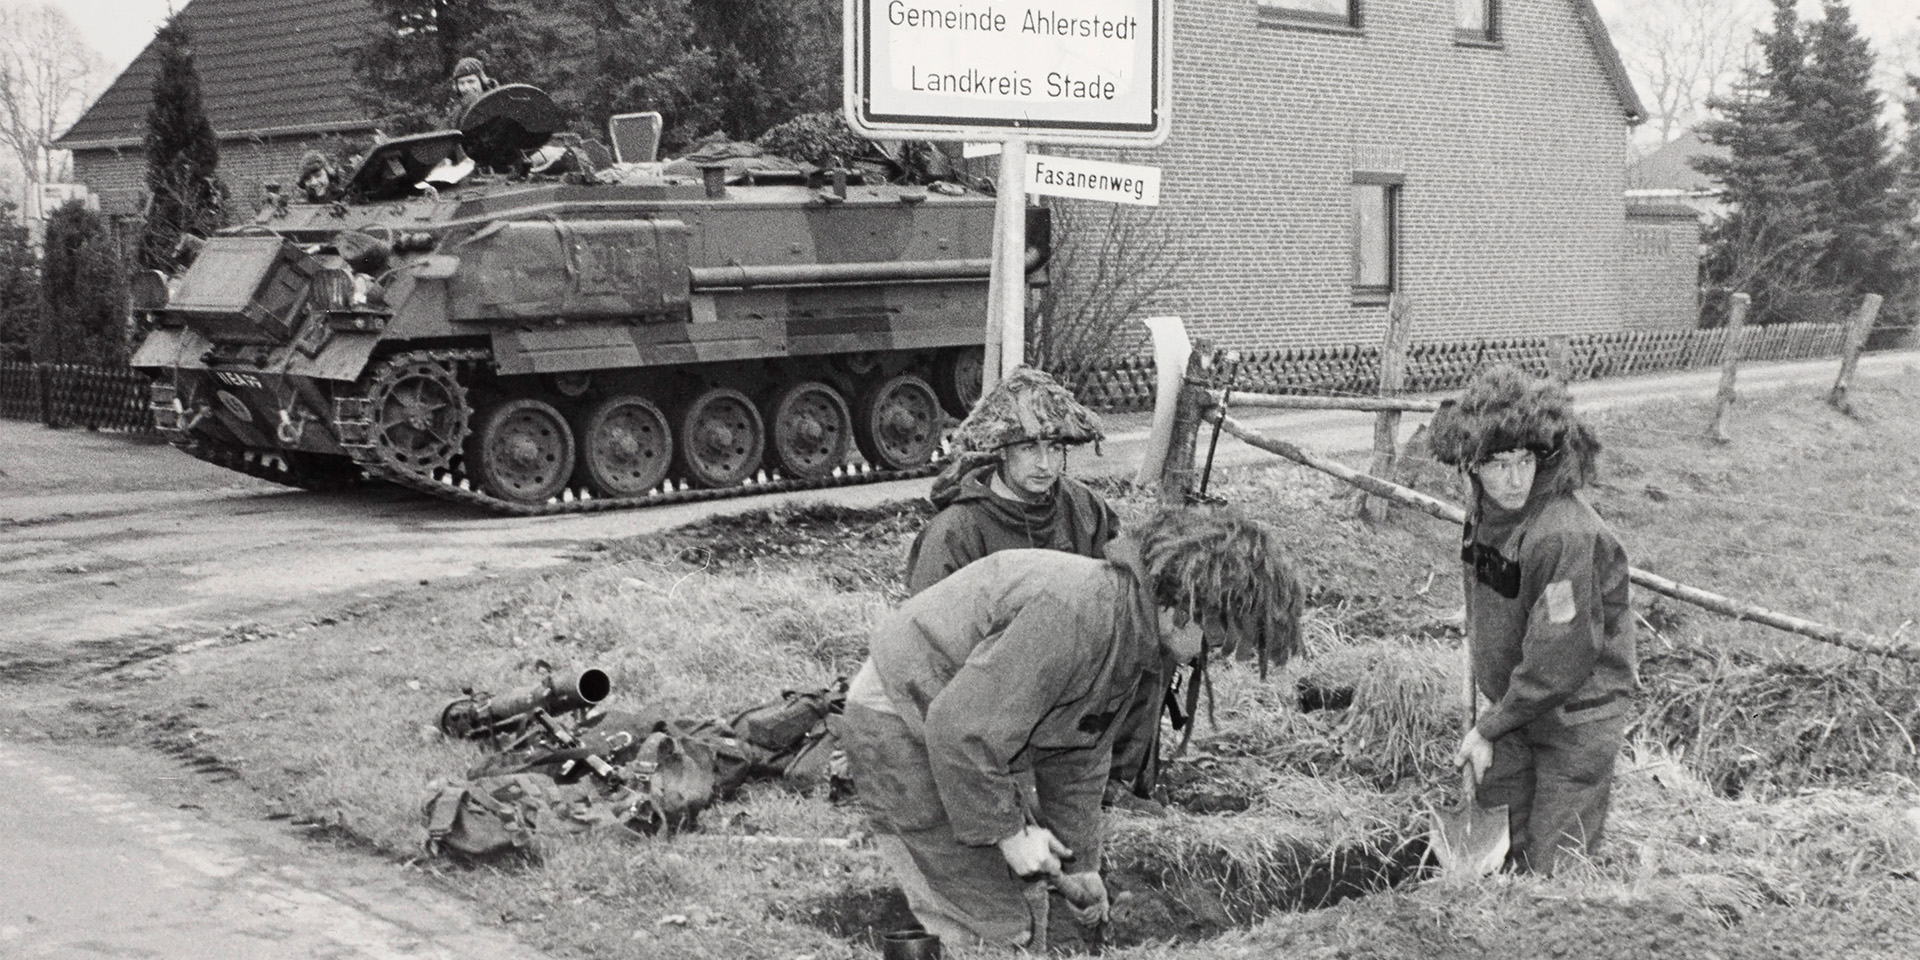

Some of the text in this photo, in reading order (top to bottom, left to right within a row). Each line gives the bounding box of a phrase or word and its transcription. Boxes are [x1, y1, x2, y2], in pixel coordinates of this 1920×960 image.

[888, 0, 1137, 40] Gemeinde Ahlerstedt
[911, 65, 1116, 100] Landkreis Stade
[1035, 161, 1144, 200] Fasanenweg
